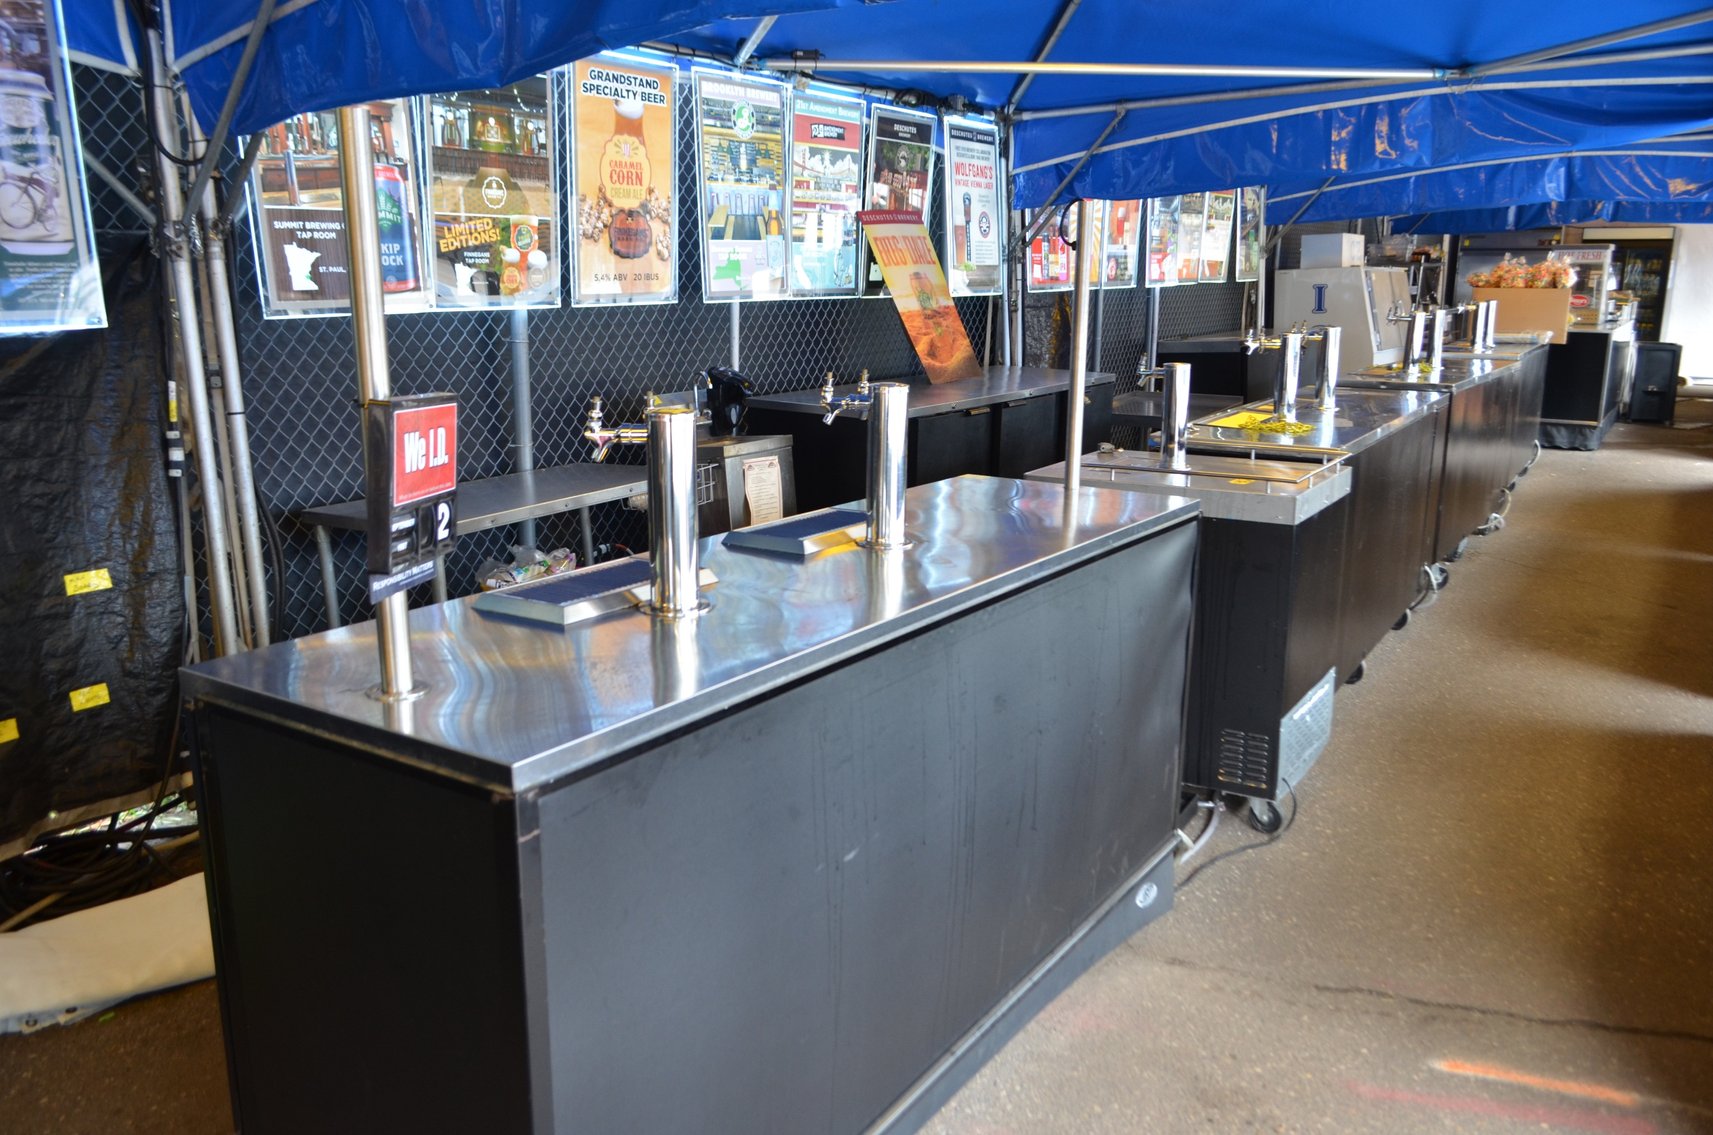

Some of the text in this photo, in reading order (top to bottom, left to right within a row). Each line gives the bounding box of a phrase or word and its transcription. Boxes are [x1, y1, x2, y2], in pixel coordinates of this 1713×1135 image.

[589, 69, 659, 90] GRANDSTAND
[582, 83, 666, 105] SPECIALTY BEER
[893, 124, 917, 134] DESCHUTES
[951, 129, 994, 142] DESCHUTES BREWERY
[609, 160, 643, 171] CARAMEL
[954, 162, 993, 180] WOLFGANG'S
[609, 169, 643, 186] CORN
[610, 188, 643, 199] CREAM ALE
[862, 213, 893, 222] DESCHUTES
[273, 221, 303, 229] SUMMIT
[305, 221, 340, 230] BREWING
[444, 218, 493, 239] LIMITED
[296, 231, 336, 240] TAP ROOM
[439, 229, 501, 253] EDITIONS!
[381, 243, 400, 255] KIP
[382, 255, 404, 266] OCK
[594, 273, 659, 282] 5.4% ABV 20 IBUS
[404, 426, 449, 474] We I.D.
[437, 502, 450, 542] 2
[373, 569, 412, 592] RESPONSIBILITY
[412, 560, 434, 576] MATTERS
